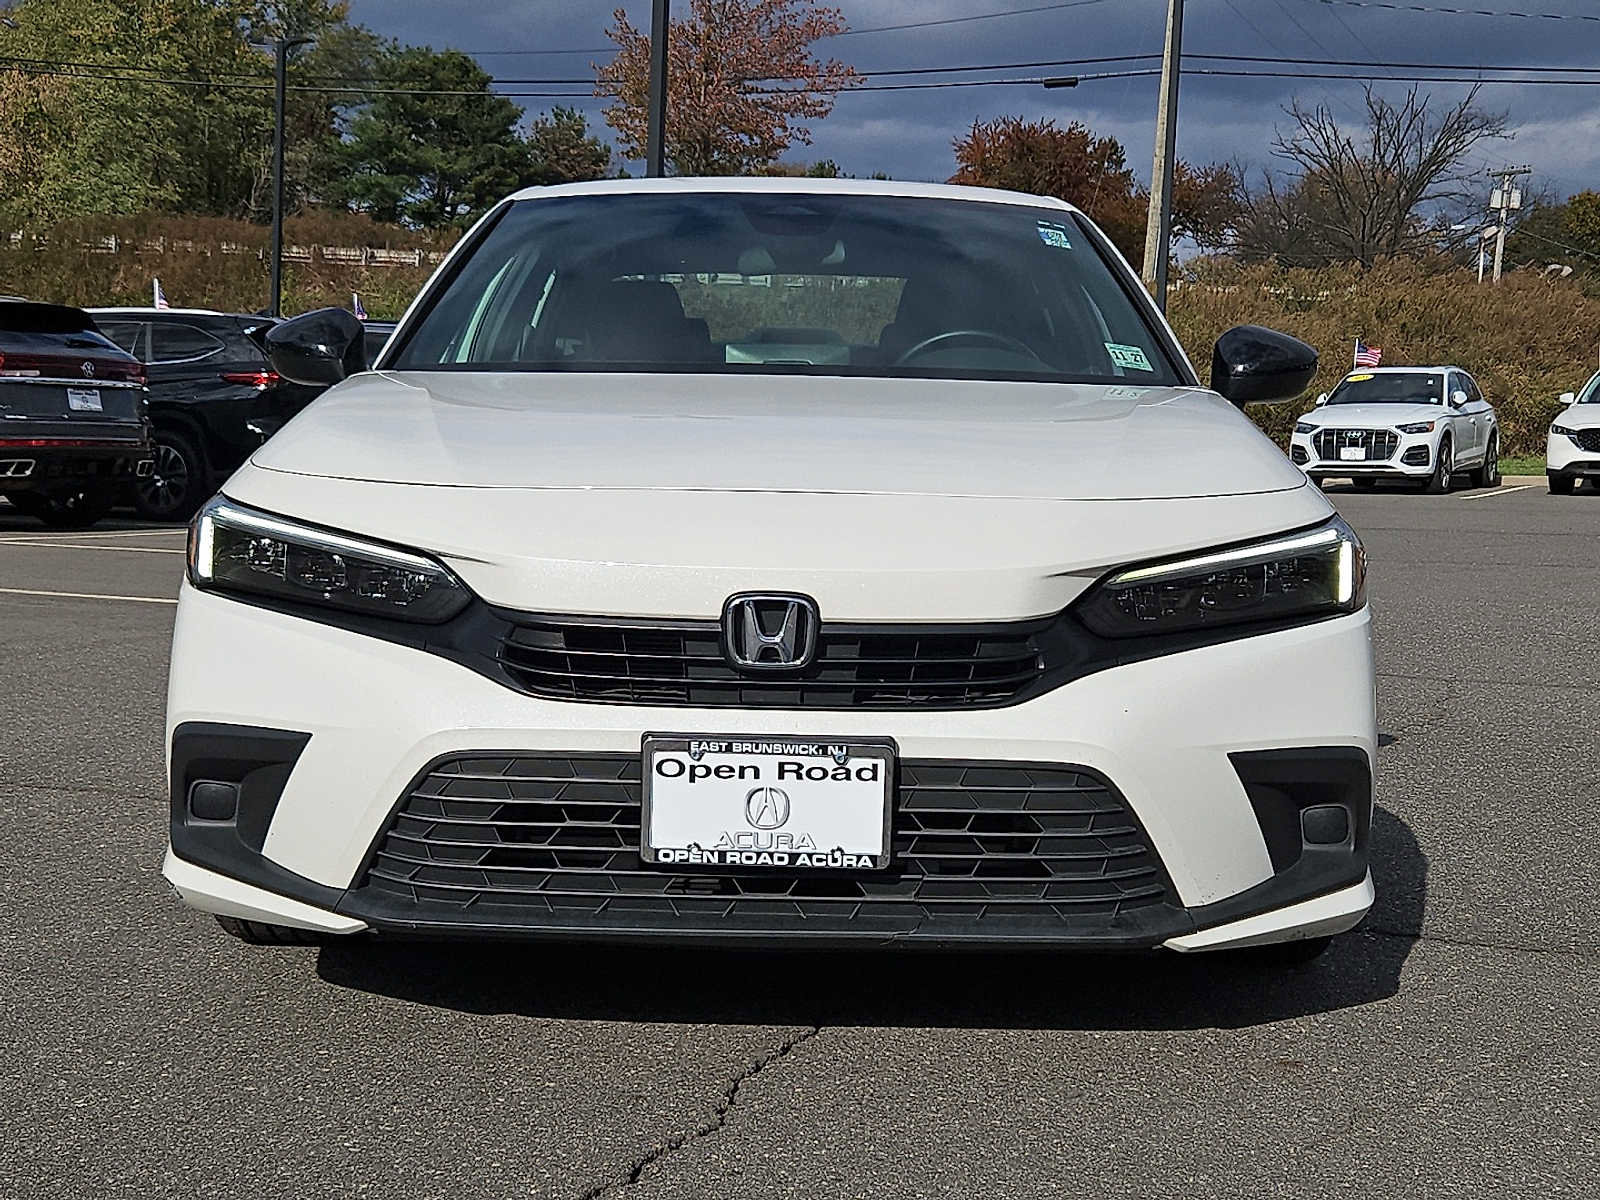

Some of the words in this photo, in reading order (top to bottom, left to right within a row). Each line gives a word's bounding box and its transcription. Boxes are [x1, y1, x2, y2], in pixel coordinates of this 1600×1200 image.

[1111, 351, 1128, 361] 11
[1130, 353, 1145, 363] 27
[690, 741, 728, 752] EAST
[827, 745, 847, 756] NJ
[655, 758, 760, 783] Open
[777, 761, 878, 782] Road
[713, 831, 817, 850] ACURA
[657, 849, 719, 864] OPEN
[725, 851, 789, 866] ROAD
[795, 853, 874, 868] ACURA
